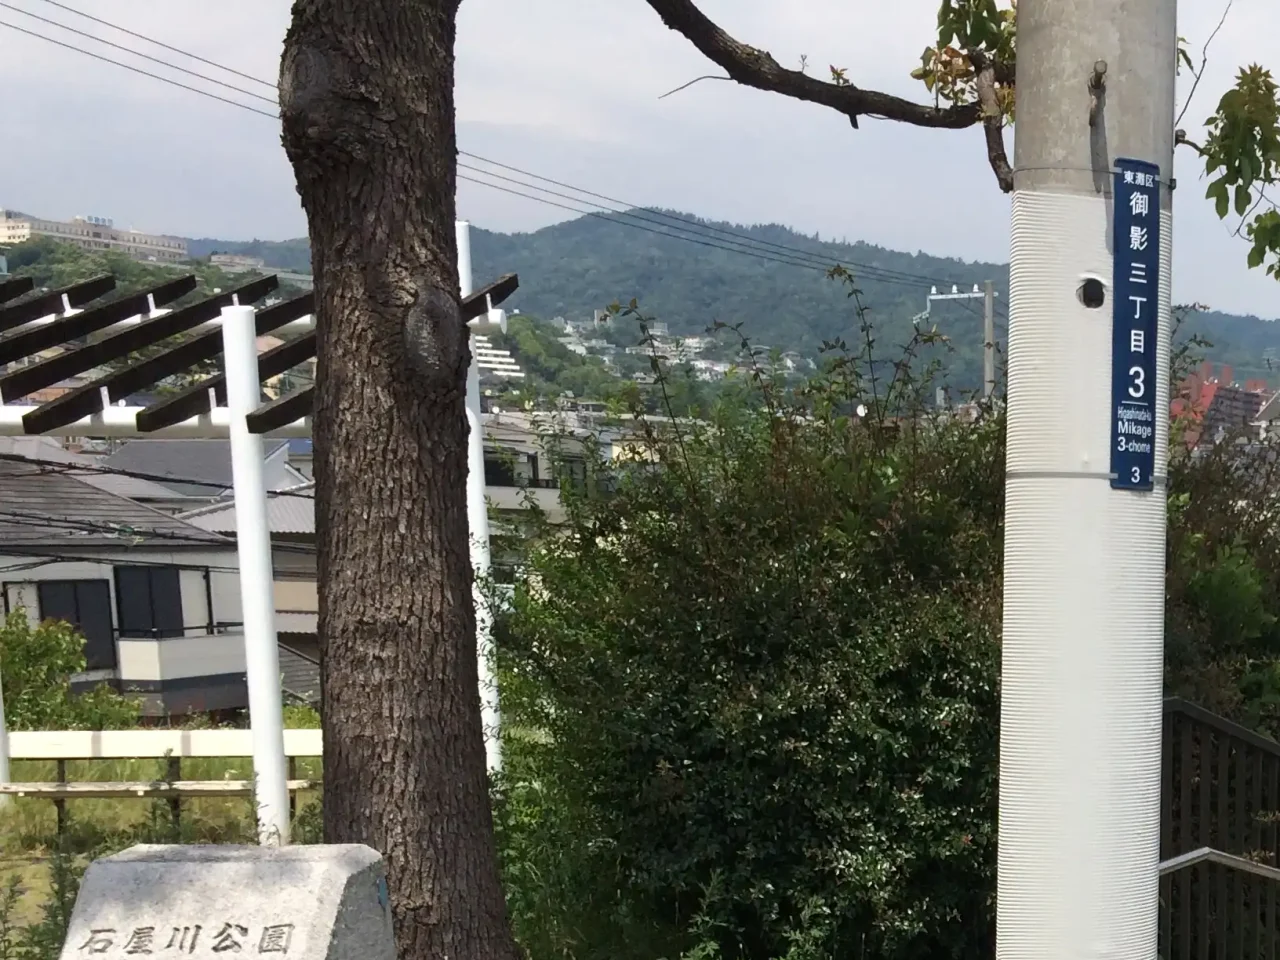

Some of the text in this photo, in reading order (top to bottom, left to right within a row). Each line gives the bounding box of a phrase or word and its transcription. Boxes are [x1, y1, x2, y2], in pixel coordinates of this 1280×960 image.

[1117, 420, 1152, 439] Mikage
[1117, 436, 1151, 454] 3-chome
[1130, 466, 1141, 483] 3
[78, 921, 296, 955] 石屋川公園
